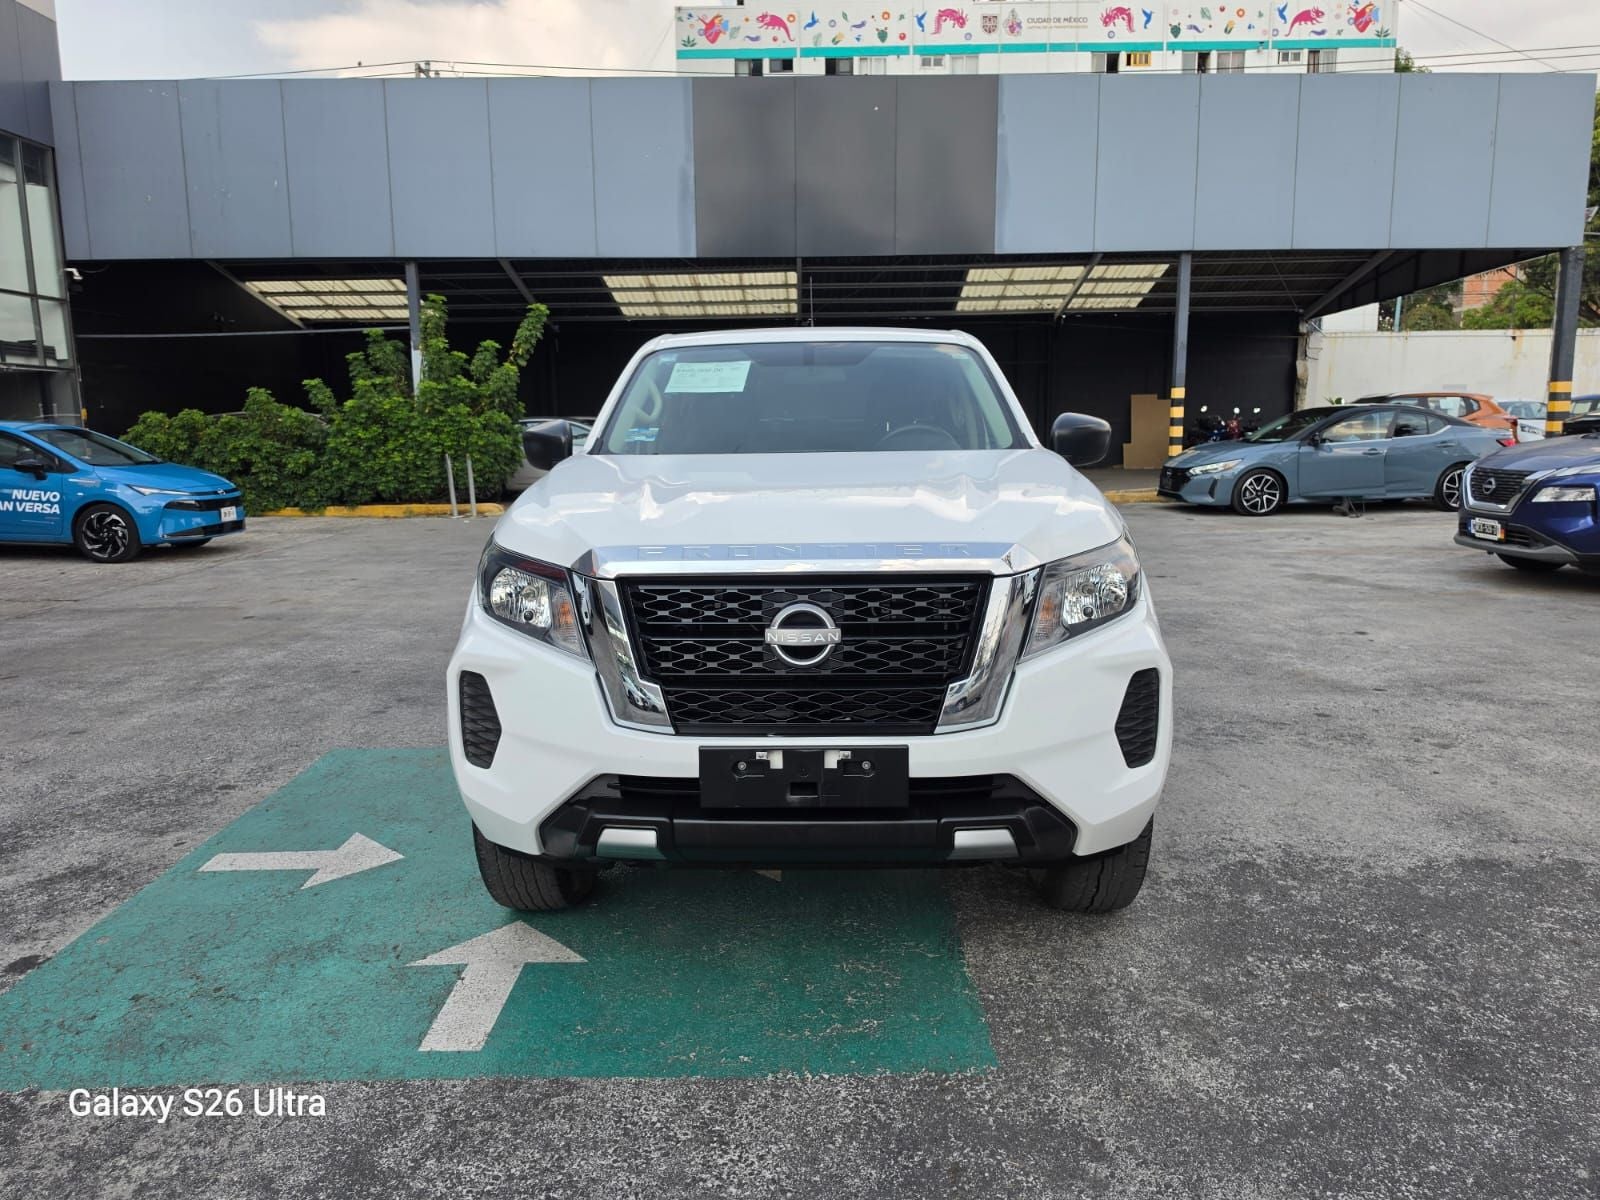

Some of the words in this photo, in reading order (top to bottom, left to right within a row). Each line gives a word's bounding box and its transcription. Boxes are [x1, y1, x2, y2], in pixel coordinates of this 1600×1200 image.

[12, 489, 60, 502] NUEVO
[16, 501, 60, 514] VERSA
[637, 544, 970, 560] FRONTIER
[767, 632, 839, 643] NISSAN
